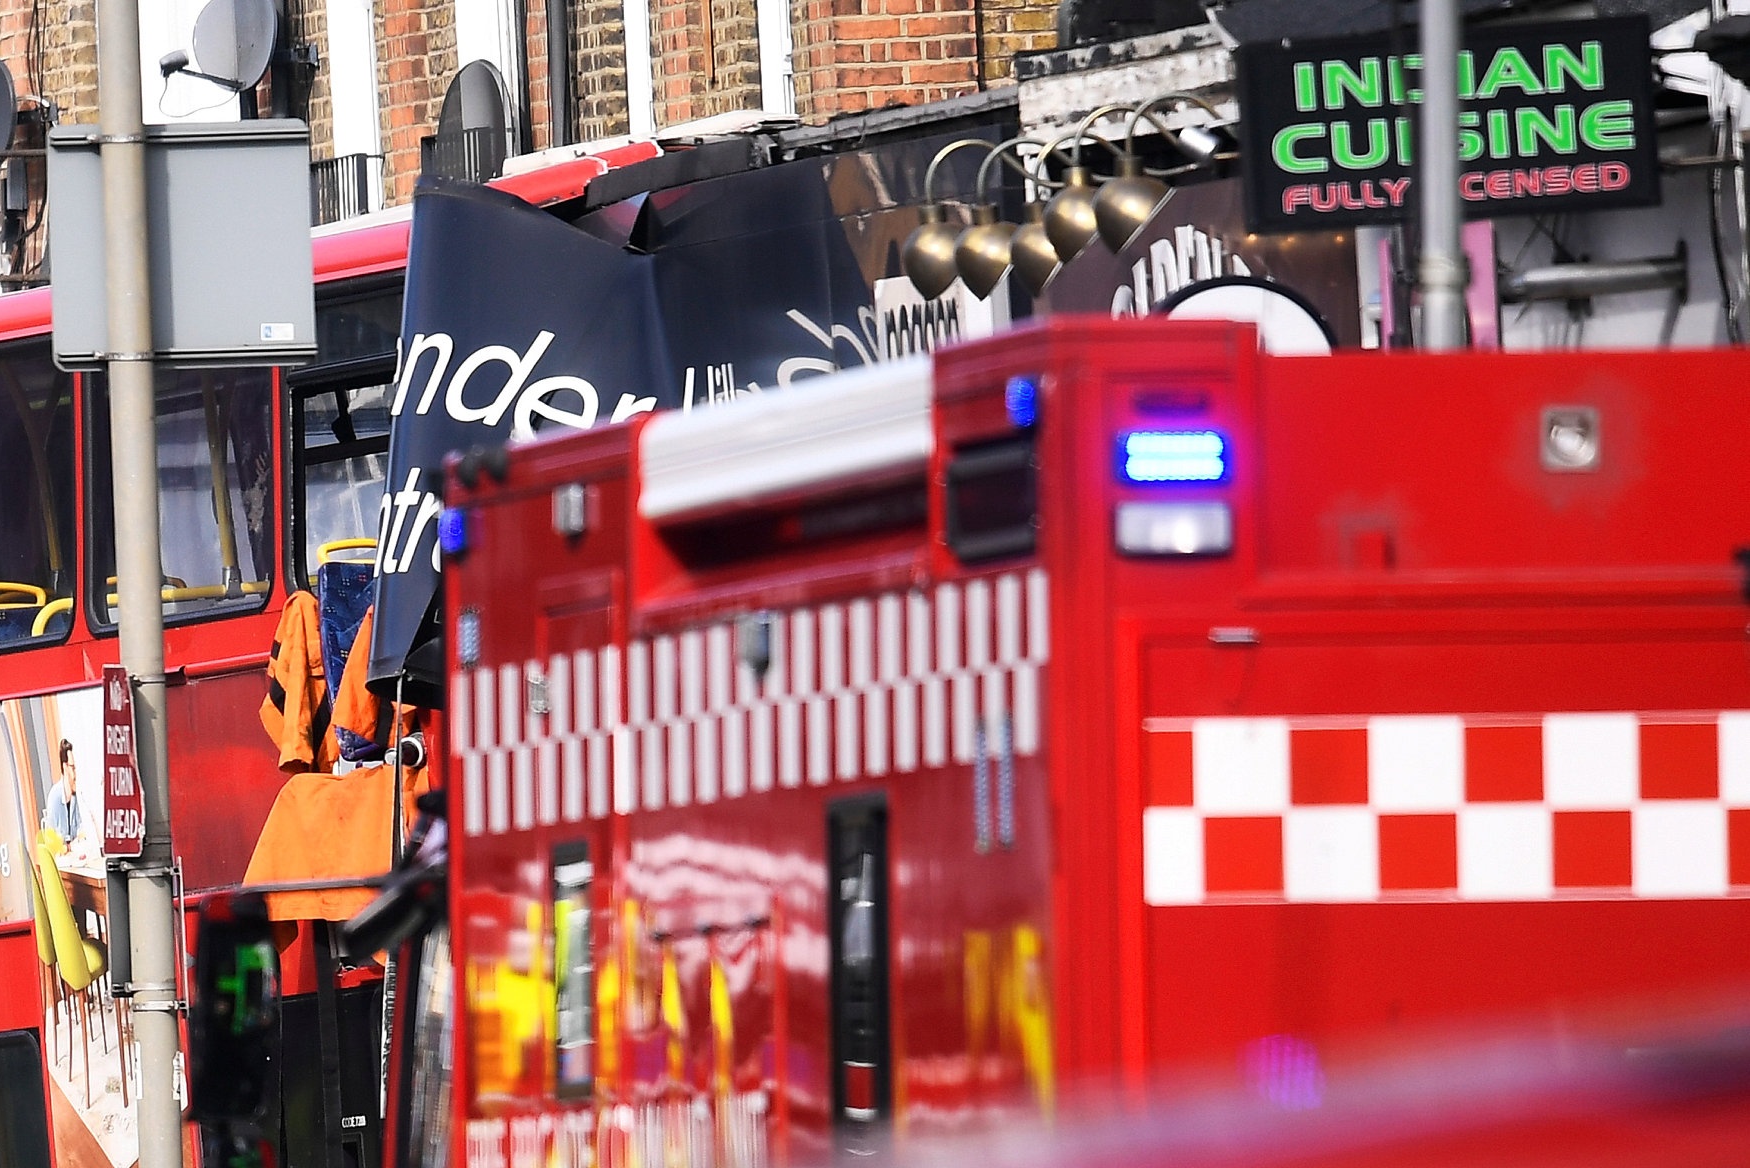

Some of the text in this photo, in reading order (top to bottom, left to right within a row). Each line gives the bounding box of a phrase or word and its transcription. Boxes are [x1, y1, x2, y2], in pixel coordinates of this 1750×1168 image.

[1293, 40, 1605, 112] INDIAN
[1282, 161, 1630, 215] FULLY CENSED
[391, 330, 658, 442] nder
[106, 725, 130, 755] RIGHT
[109, 767, 135, 797] TURN
[105, 809, 139, 839] AHEAD
